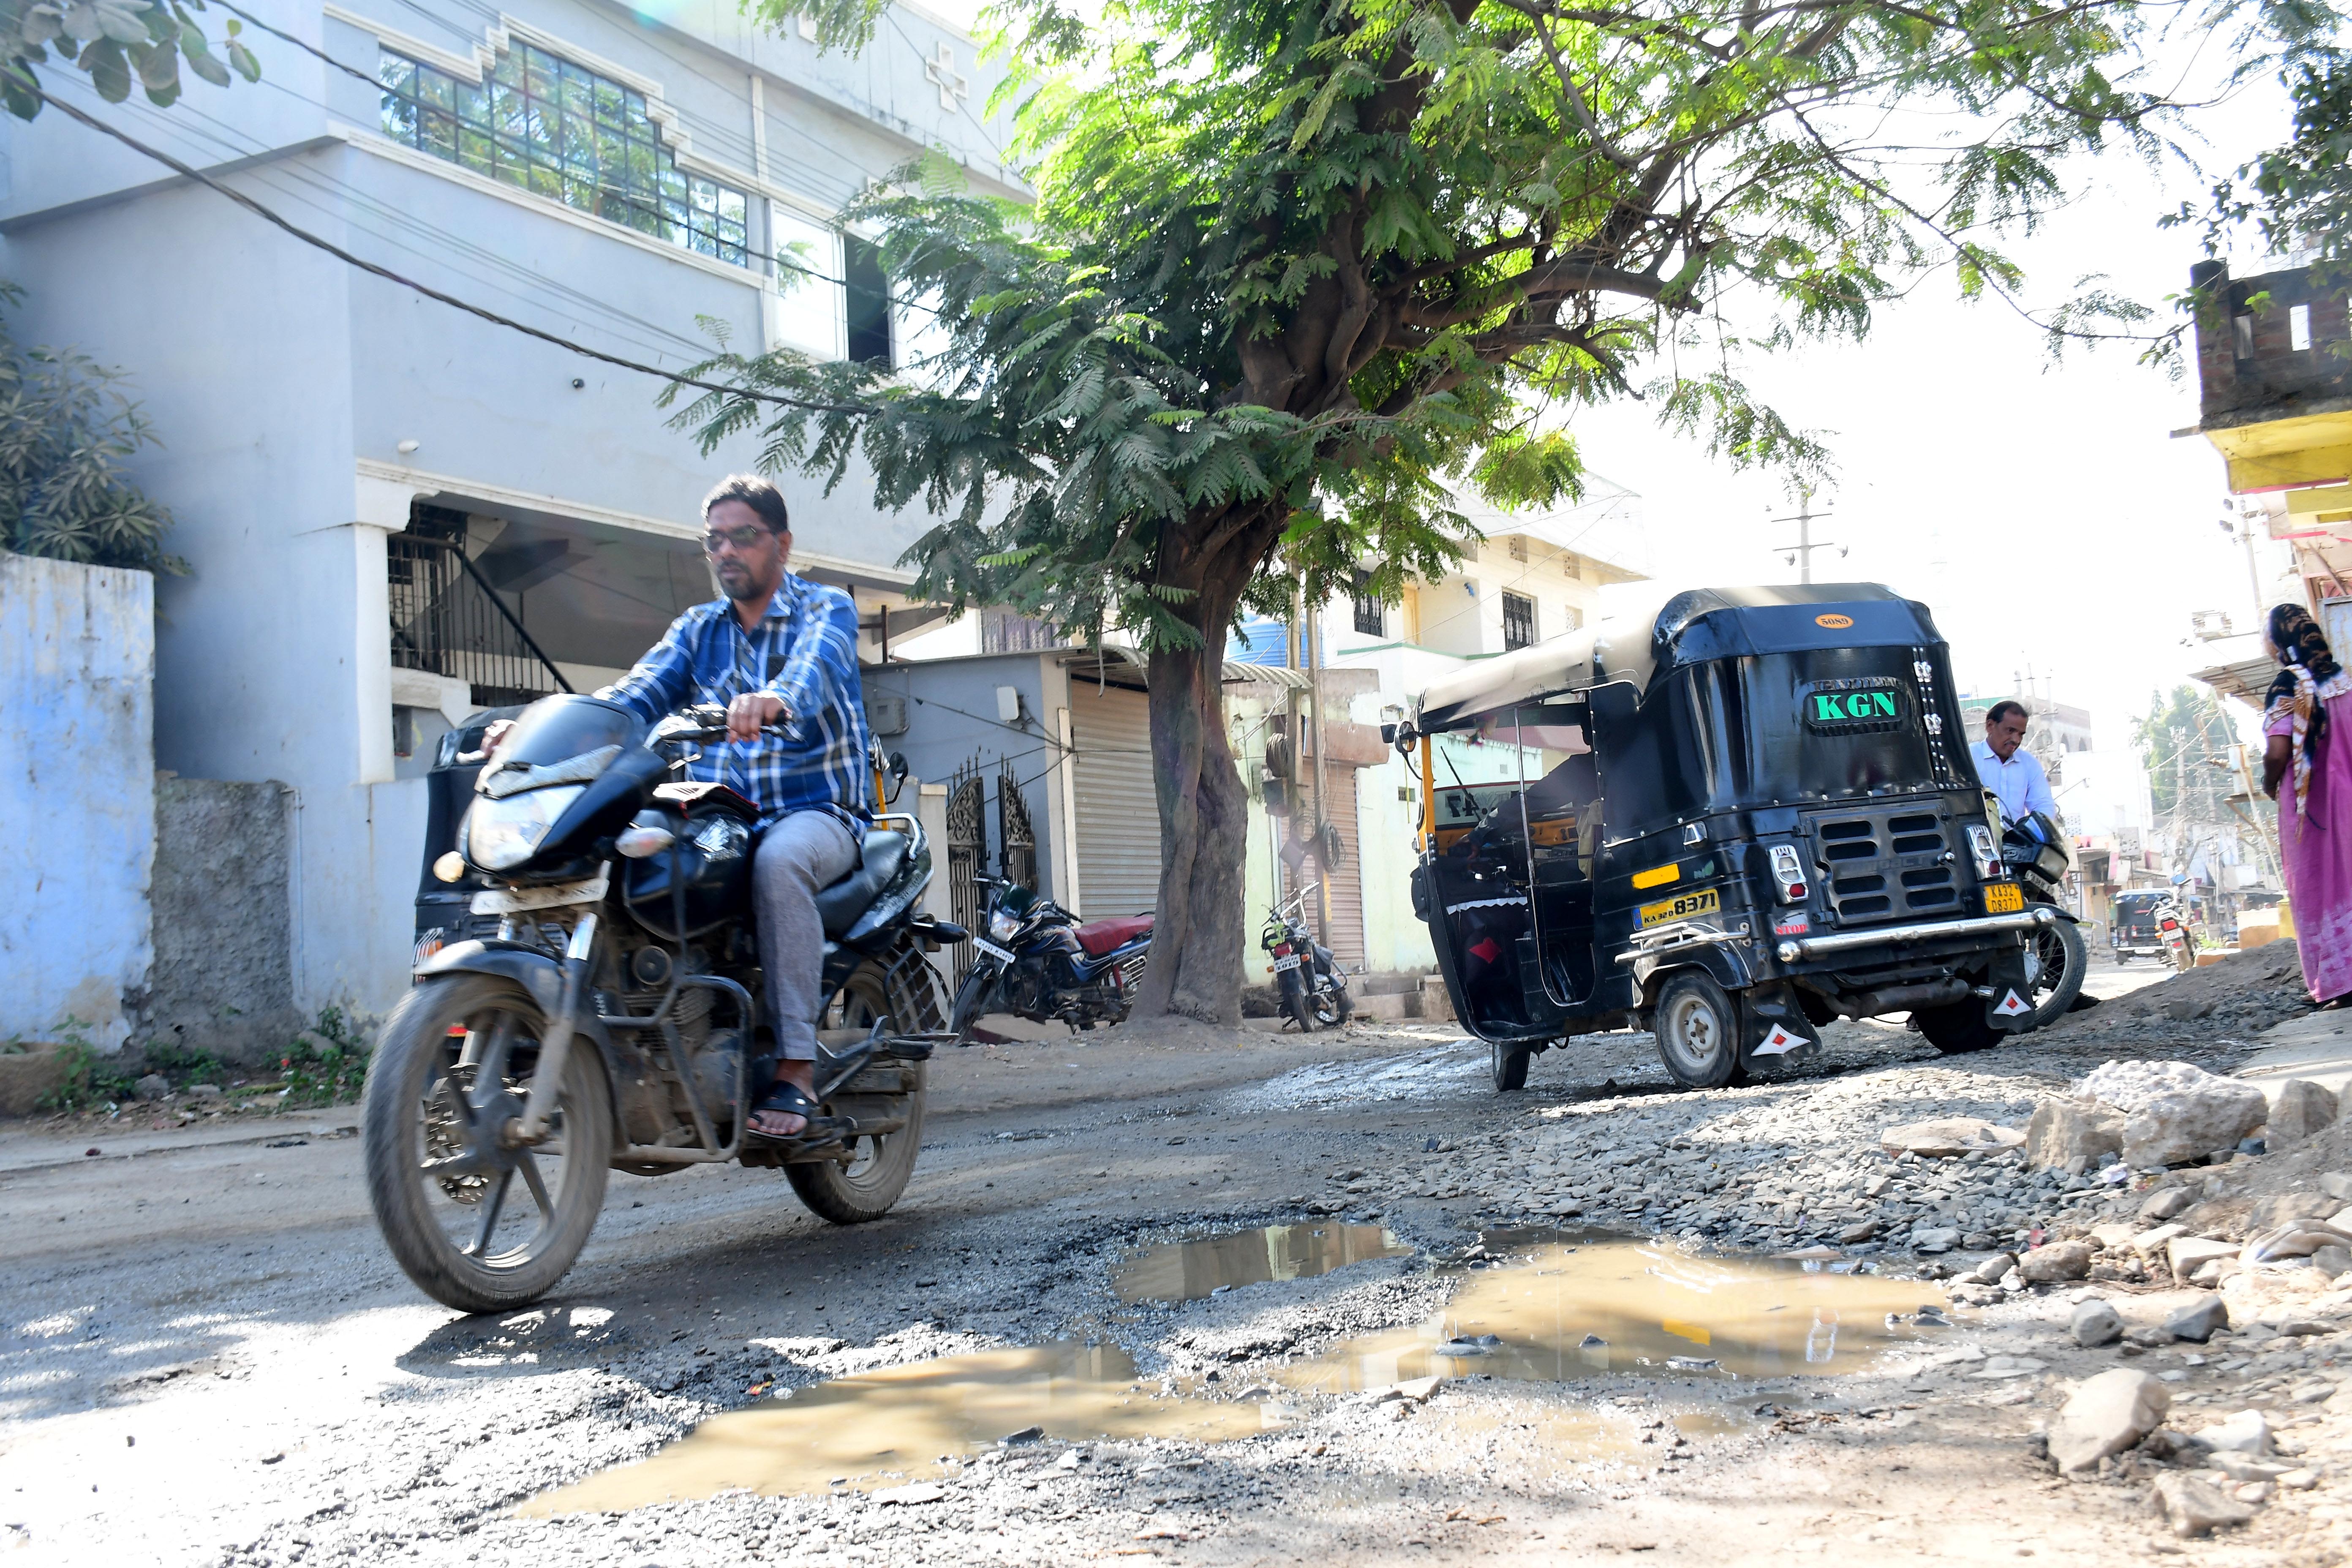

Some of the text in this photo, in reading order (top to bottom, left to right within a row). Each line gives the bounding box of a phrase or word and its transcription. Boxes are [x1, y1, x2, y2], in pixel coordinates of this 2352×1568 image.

[1814, 692, 1895, 720] KGN
[1991, 885, 2013, 898] KA32
[1674, 893, 1715, 915] 8371
[1992, 898, 2018, 912] D8371
[1776, 924, 1807, 935] STOP
